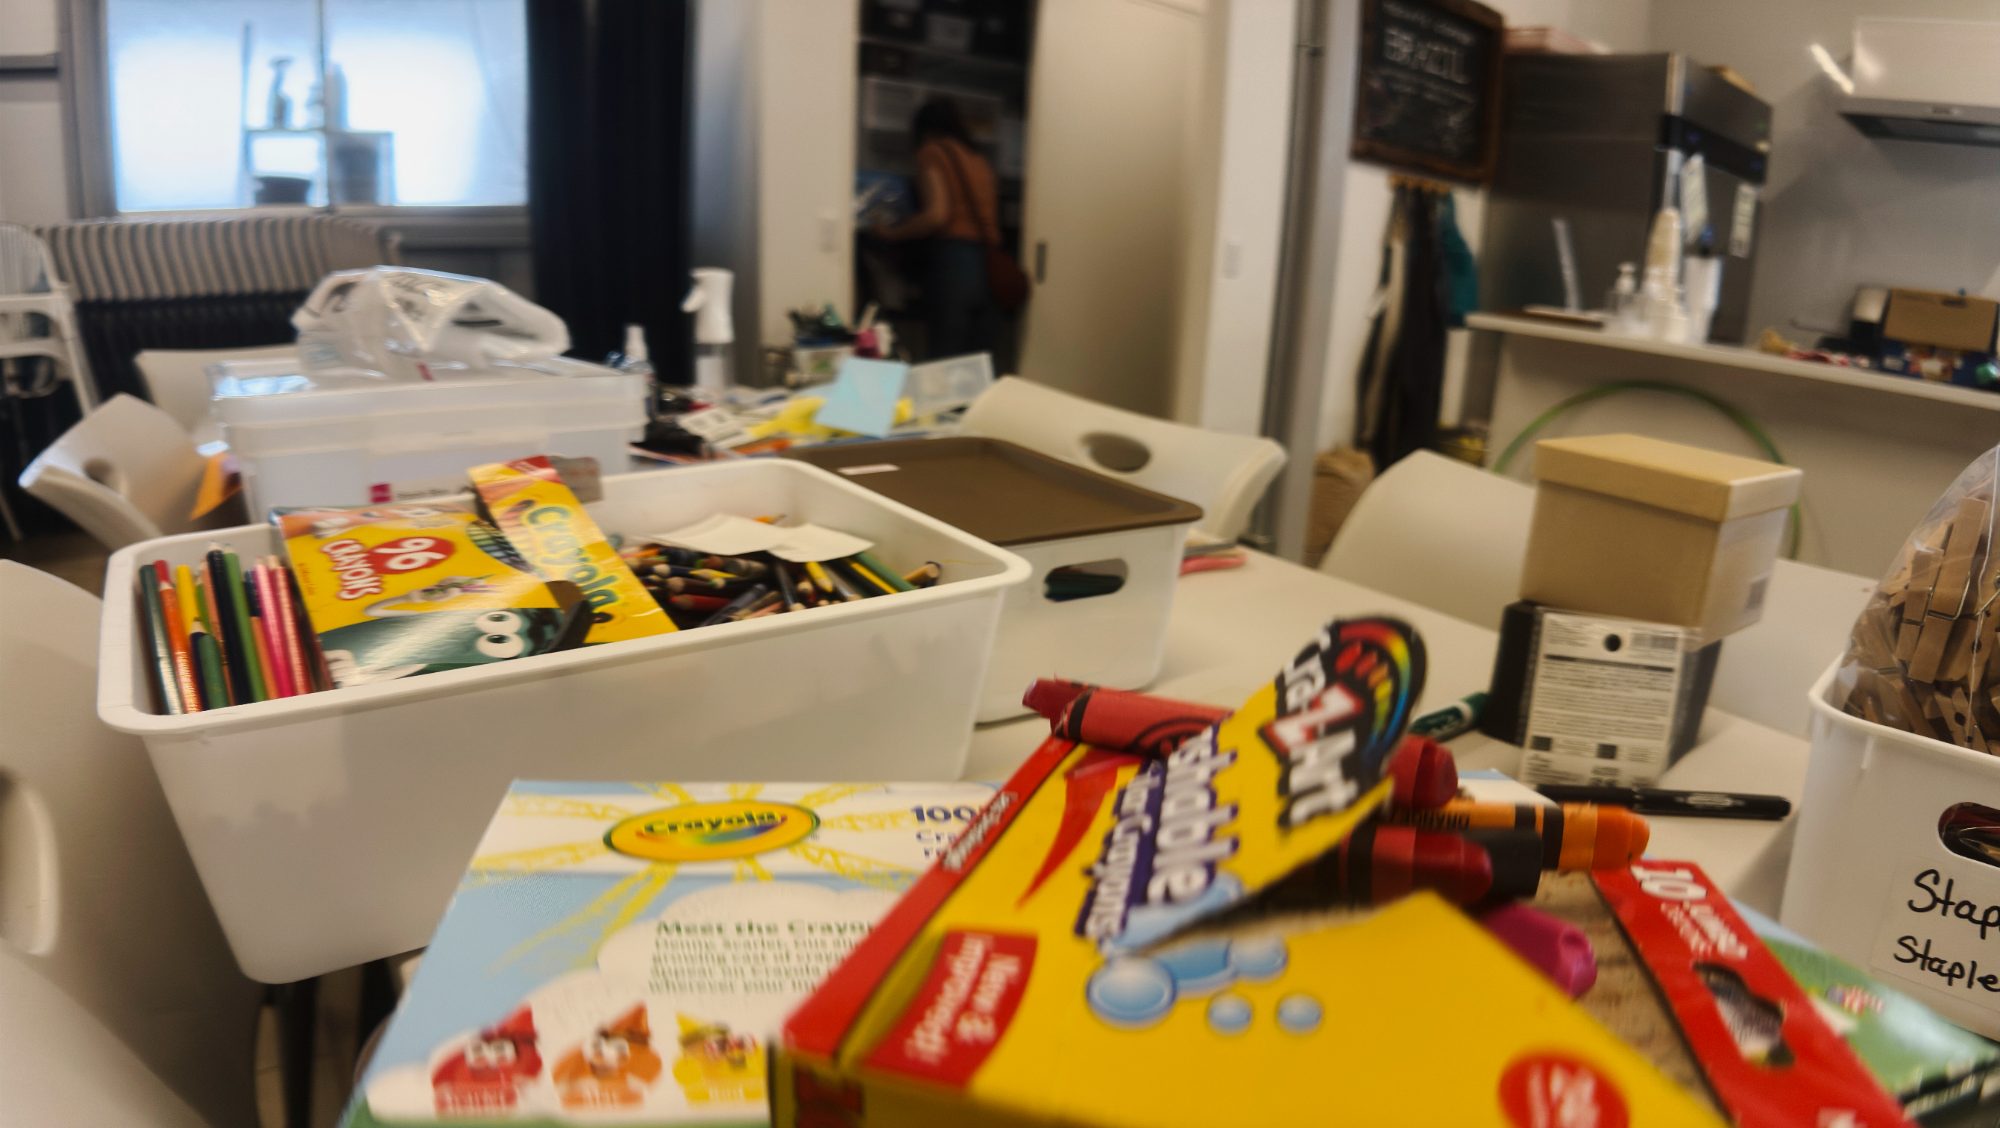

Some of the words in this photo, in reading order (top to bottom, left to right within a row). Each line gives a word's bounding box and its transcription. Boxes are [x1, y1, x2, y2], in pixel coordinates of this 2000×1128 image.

[319, 538, 385, 602] CRAYONS
[373, 537, 447, 571] 96
[526, 506, 619, 608] Crayola
[643, 810, 779, 835] Crayola
[1630, 864, 1708, 901] 10
[657, 920, 723, 936] Meet
[735, 919, 779, 935] the
[1893, 934, 2000, 993] Staple
